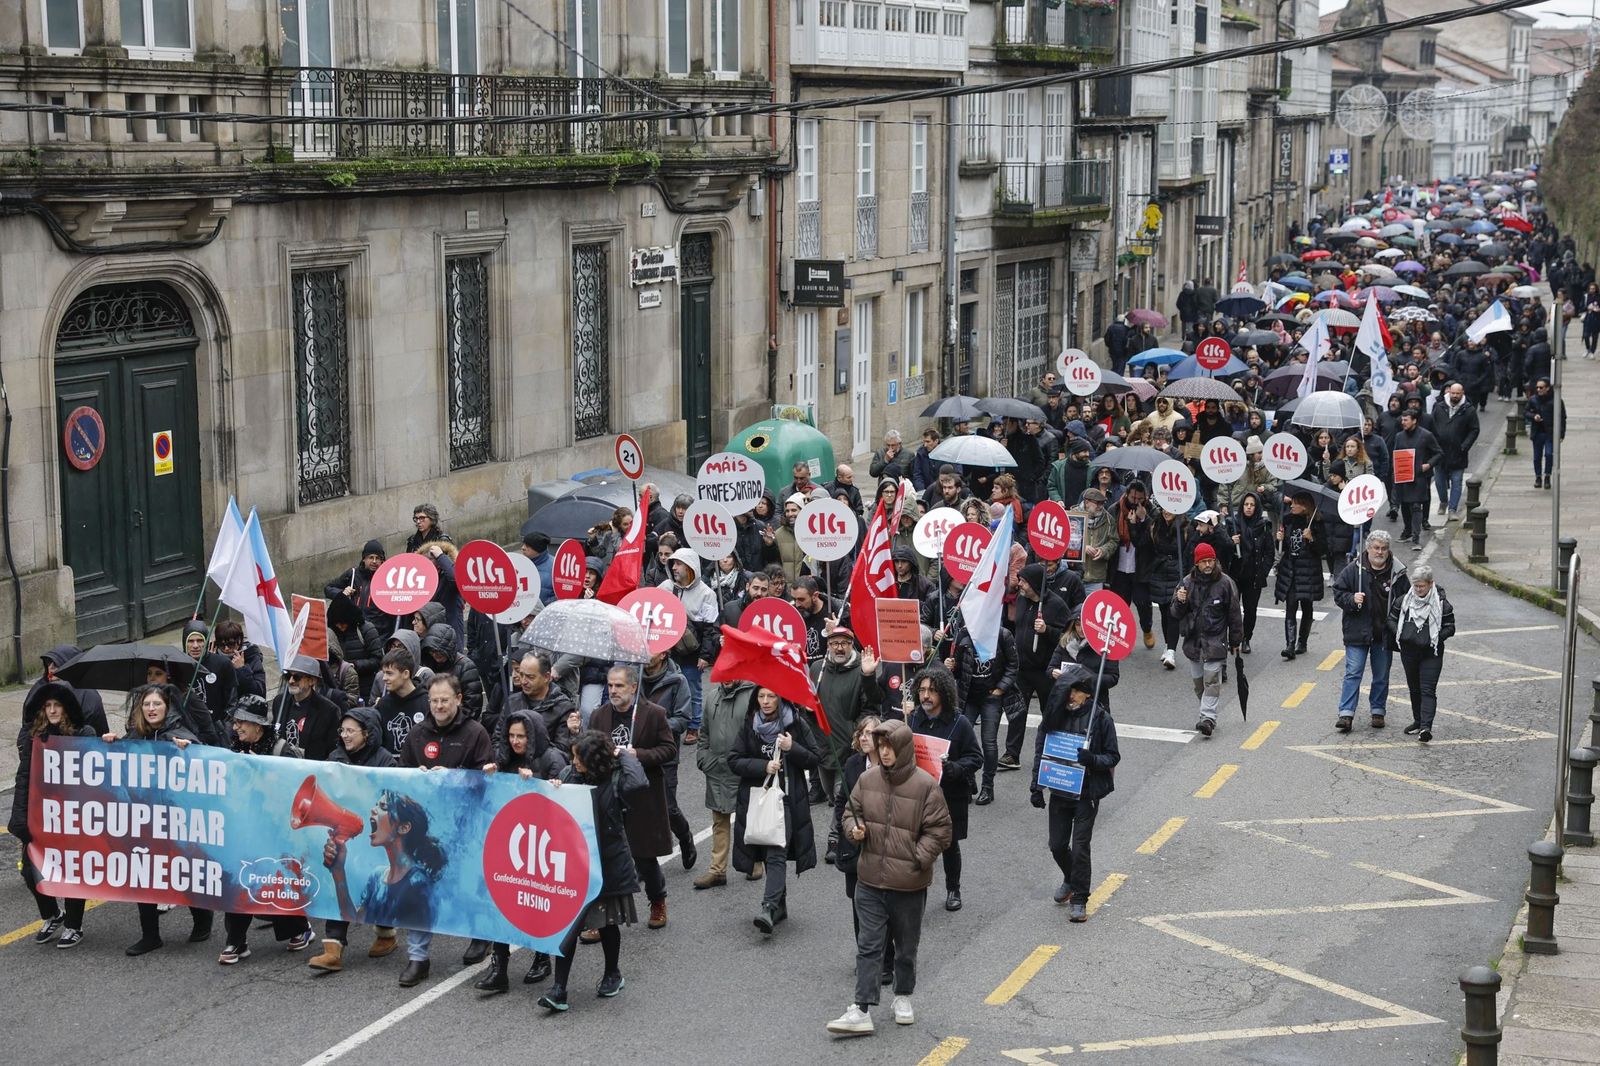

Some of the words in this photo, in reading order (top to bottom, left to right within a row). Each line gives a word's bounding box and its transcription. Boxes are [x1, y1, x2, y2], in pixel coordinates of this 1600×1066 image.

[1203, 344, 1225, 358] CIG
[1072, 367, 1094, 380] CIG
[623, 450, 636, 465] 21
[1209, 447, 1238, 465] CIG
[1272, 443, 1299, 462] CIG
[706, 456, 748, 475] MÁIS
[698, 480, 762, 501] PROFESORADO
[1161, 472, 1187, 492] CIG
[1348, 485, 1375, 505] CIG
[694, 513, 727, 536] CIG
[808, 512, 846, 535] CIG
[1037, 511, 1063, 539] CIG
[466, 556, 506, 584] CIG
[560, 552, 581, 579] CIG
[386, 566, 426, 589] CIG
[478, 591, 499, 599] ENSINO
[629, 600, 674, 628] CIG
[1095, 601, 1127, 640] CIG
[43, 749, 227, 796] RECTIFICAR
[42, 798, 225, 847] RECUPERAR
[508, 822, 567, 882] CIG
[41, 846, 223, 897] RECOÑECER
[248, 873, 311, 887] Profesorado
[261, 890, 275, 898] en
[277, 889, 300, 900] loita
[493, 872, 530, 886] Confederación
[556, 885, 577, 899] Galega
[517, 890, 551, 912] ENSINO
